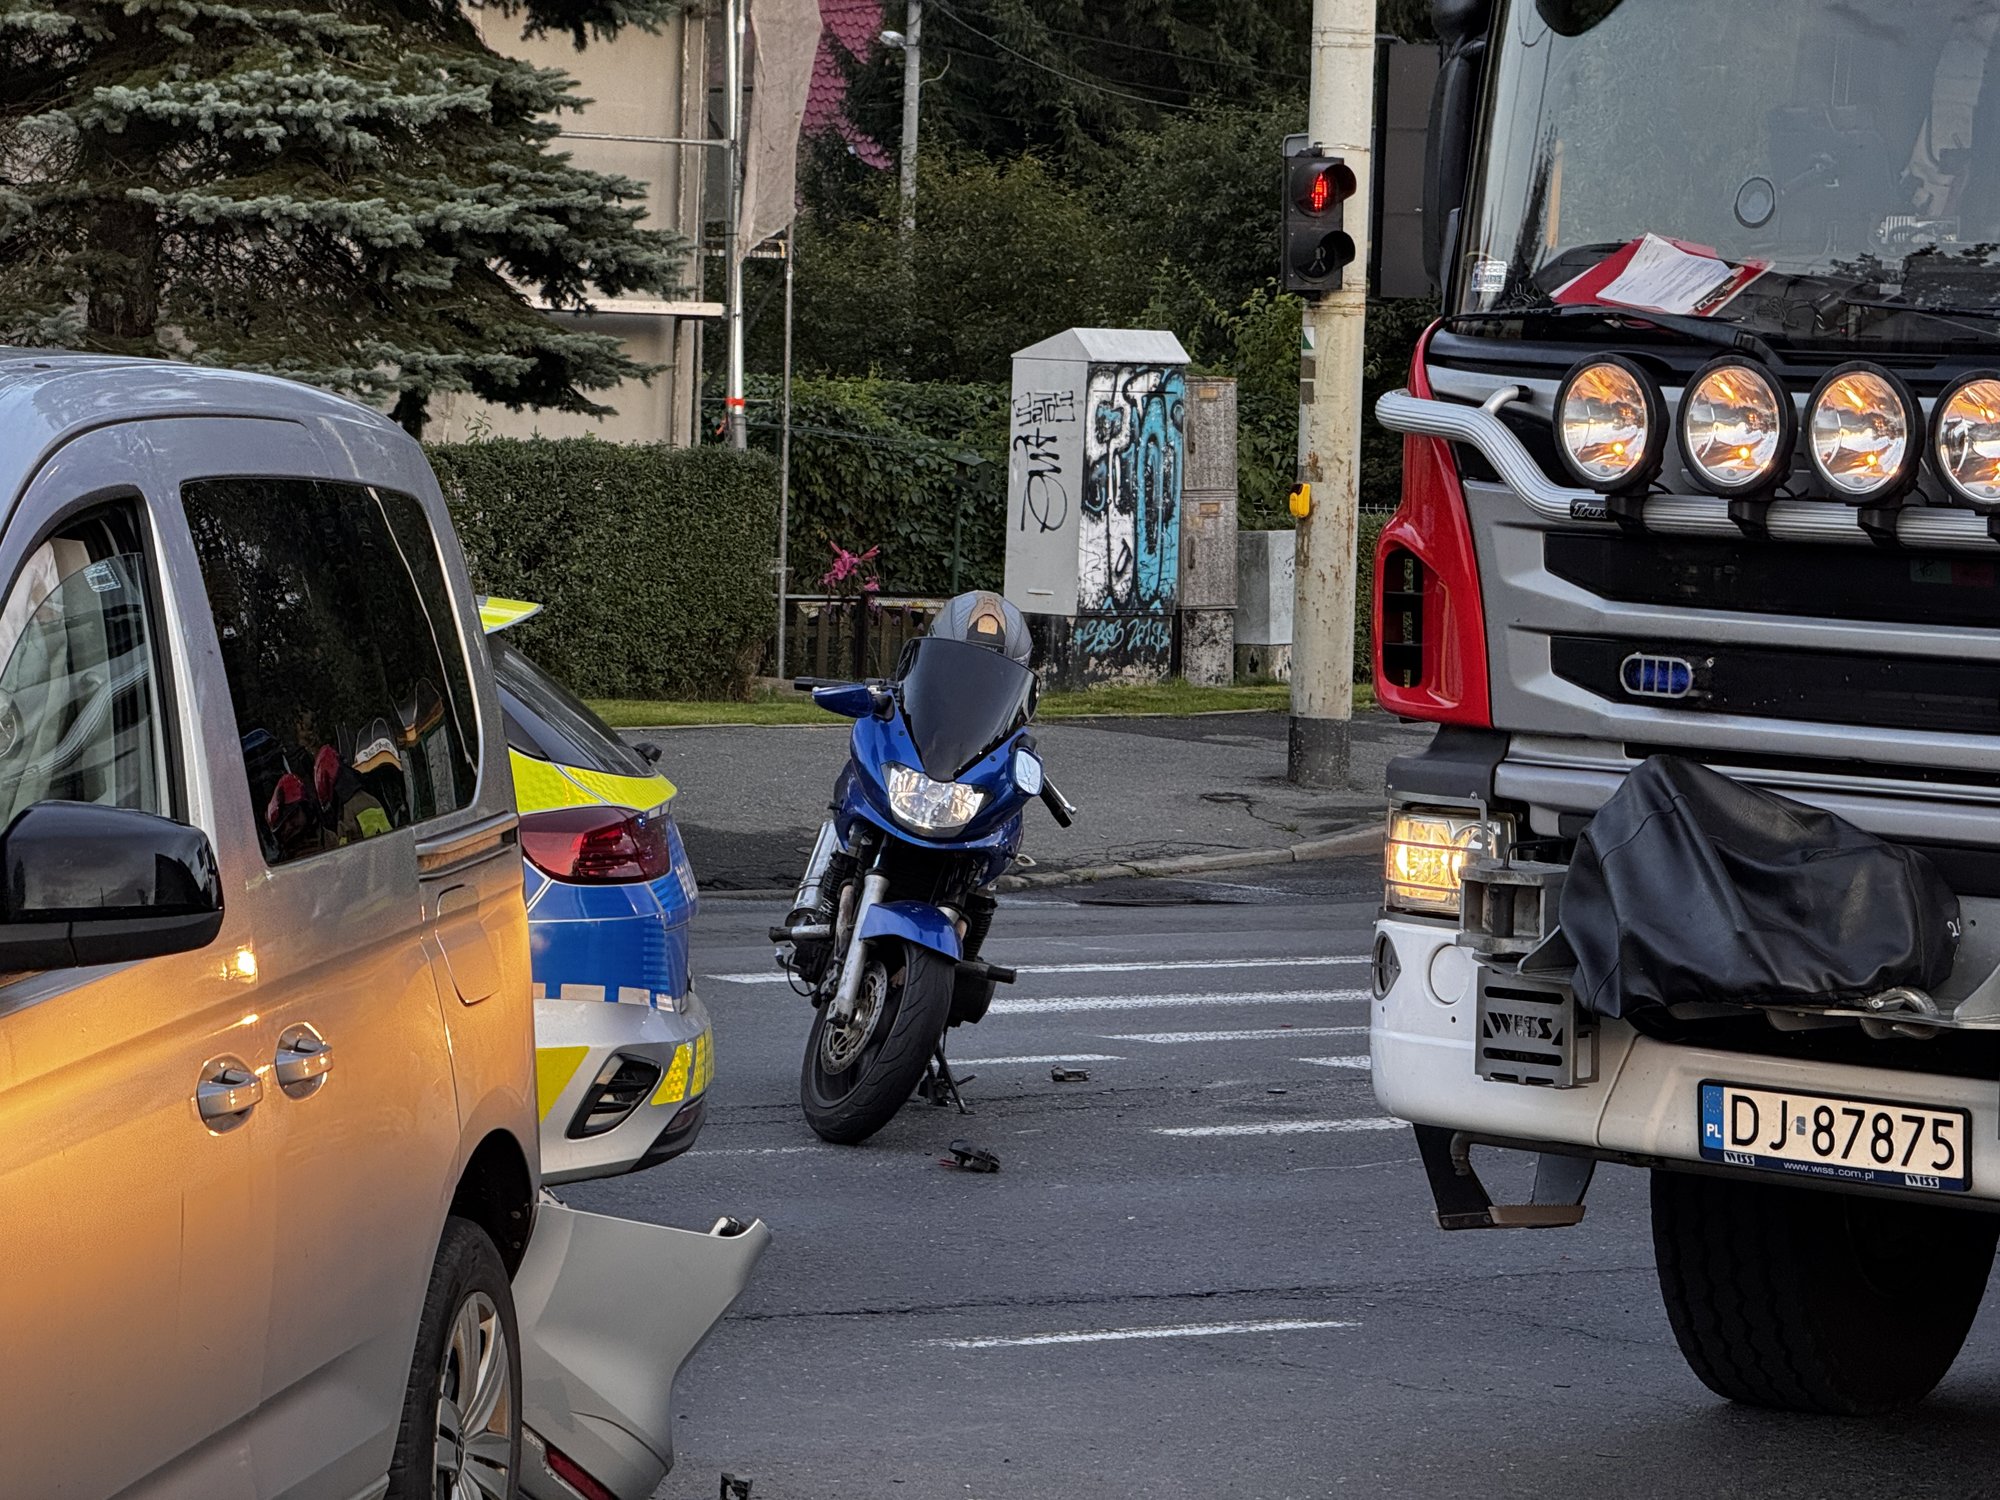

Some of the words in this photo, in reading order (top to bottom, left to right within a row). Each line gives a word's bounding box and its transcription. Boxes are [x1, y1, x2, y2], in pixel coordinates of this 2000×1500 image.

[1706, 1123, 1722, 1138] PL
[1731, 1094, 1788, 1151] DJ
[1812, 1105, 1955, 1171] 87875
[1725, 1151, 1755, 1166] WISS
[1783, 1162, 1875, 1180] www.wiss.com.pl
[1906, 1174, 1940, 1188] WISS
